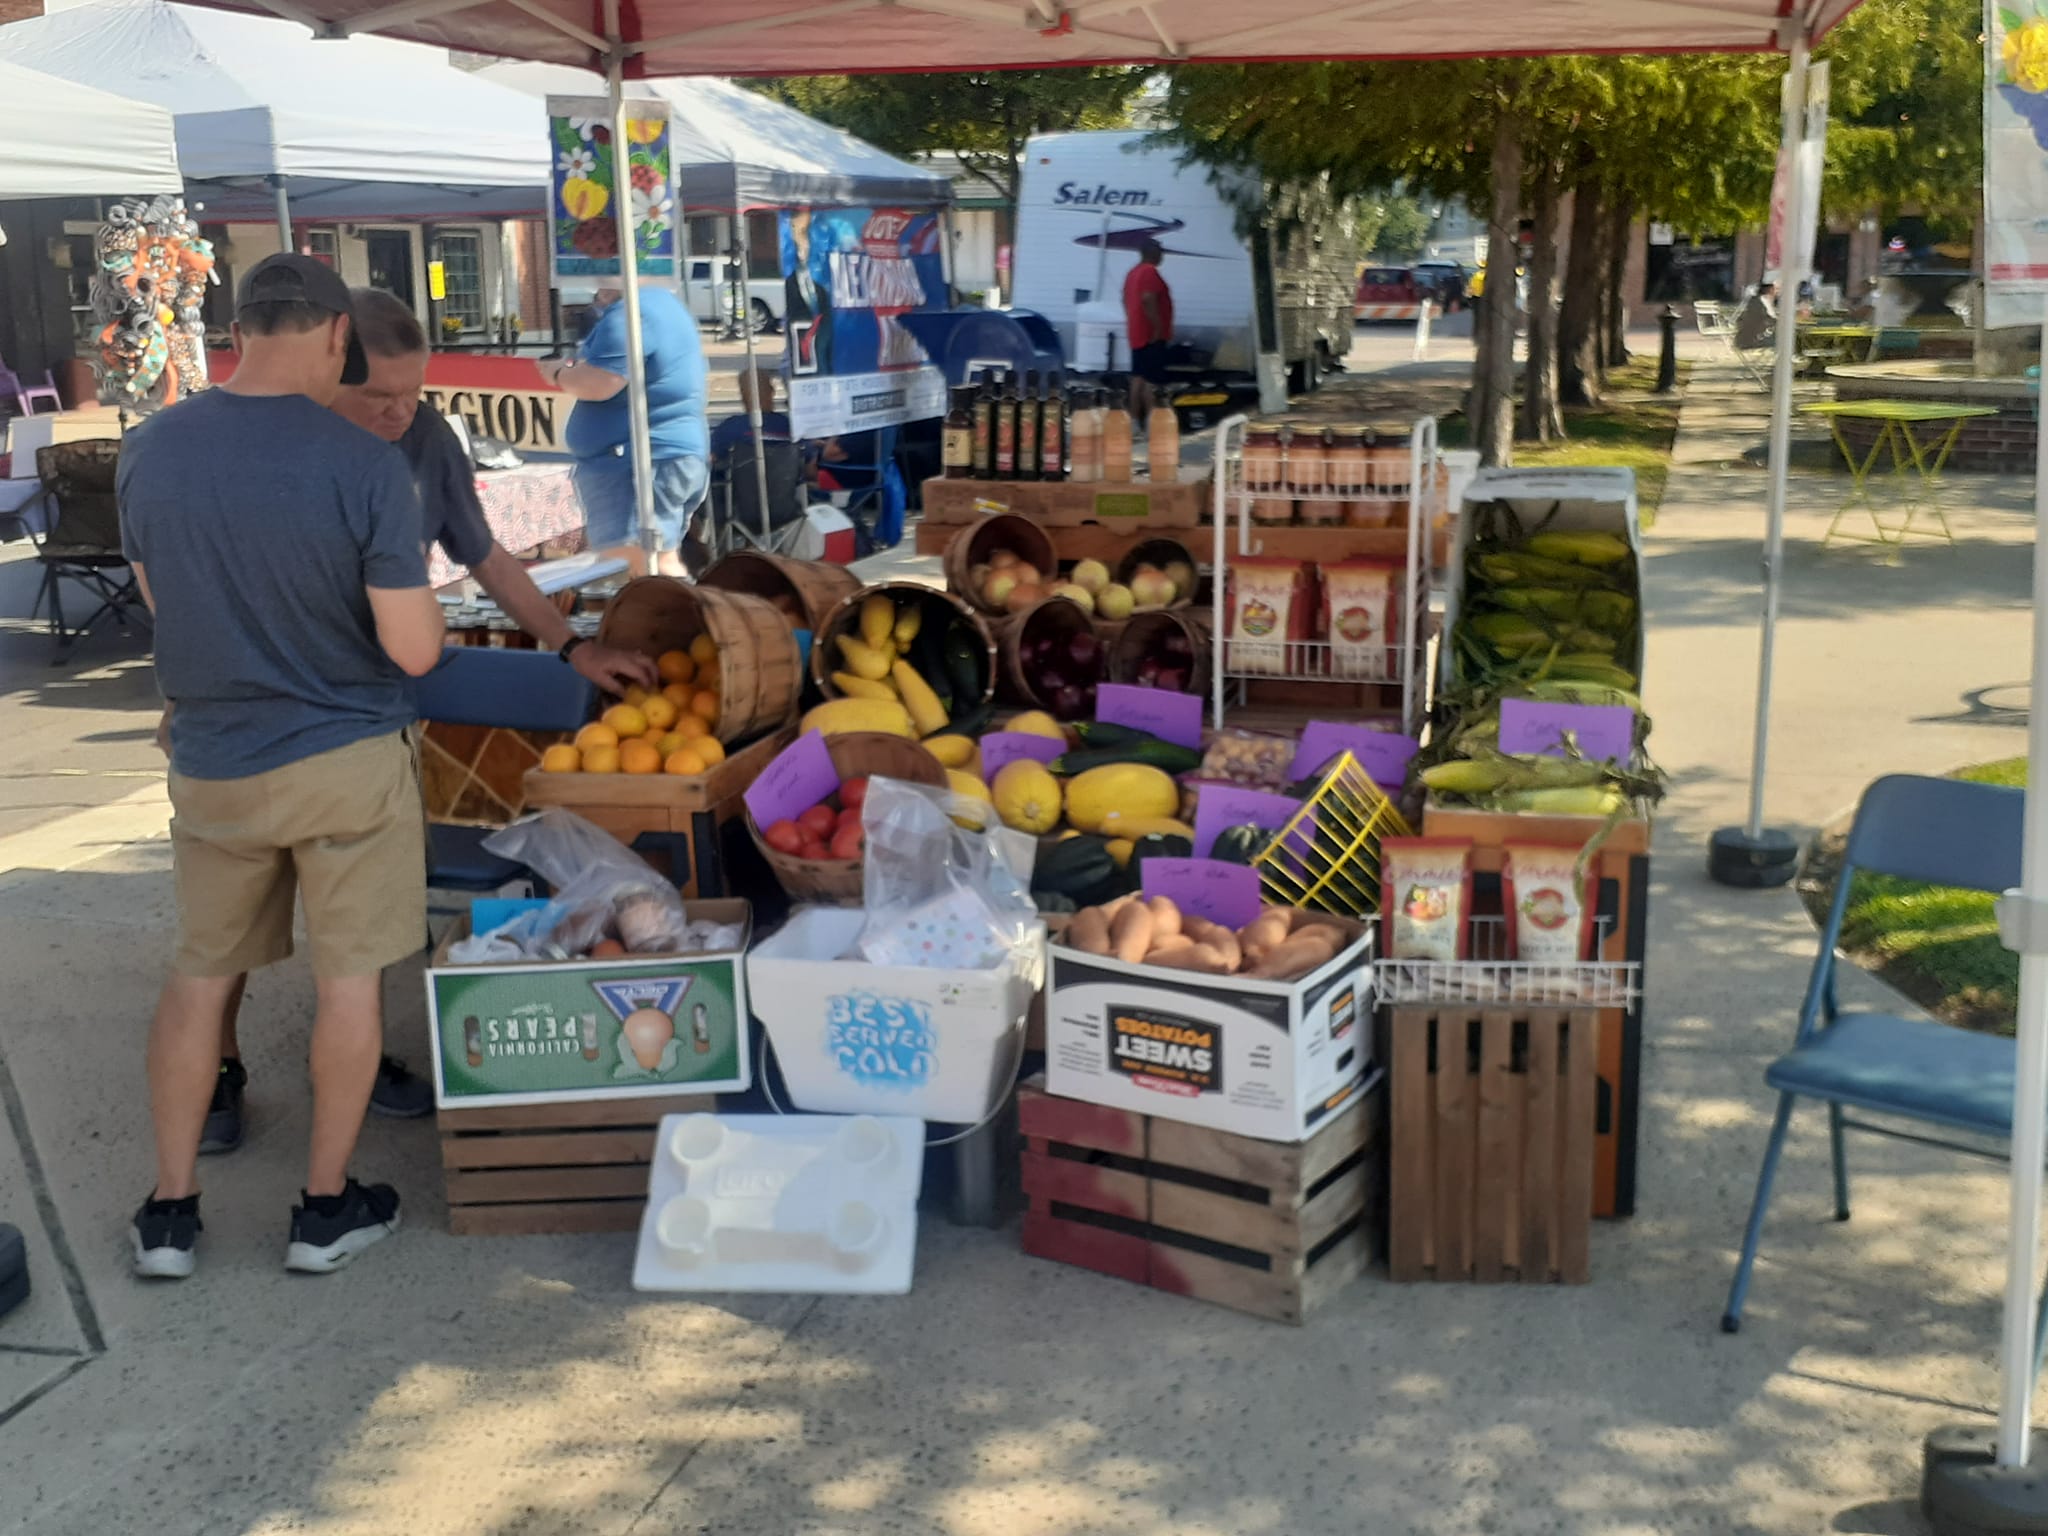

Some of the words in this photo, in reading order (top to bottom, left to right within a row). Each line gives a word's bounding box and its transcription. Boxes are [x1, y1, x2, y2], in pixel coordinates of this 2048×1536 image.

[1053, 182, 1149, 206] Salem
[829, 996, 933, 1028] BEST
[488, 1015, 577, 1041] PEARS
[829, 1023, 938, 1049] SERVED
[1114, 1016, 1213, 1049] POTATOES
[488, 1038, 580, 1058] CALIFORNIA
[836, 1046, 940, 1078] COLD
[1114, 1034, 1213, 1073] SWEET
